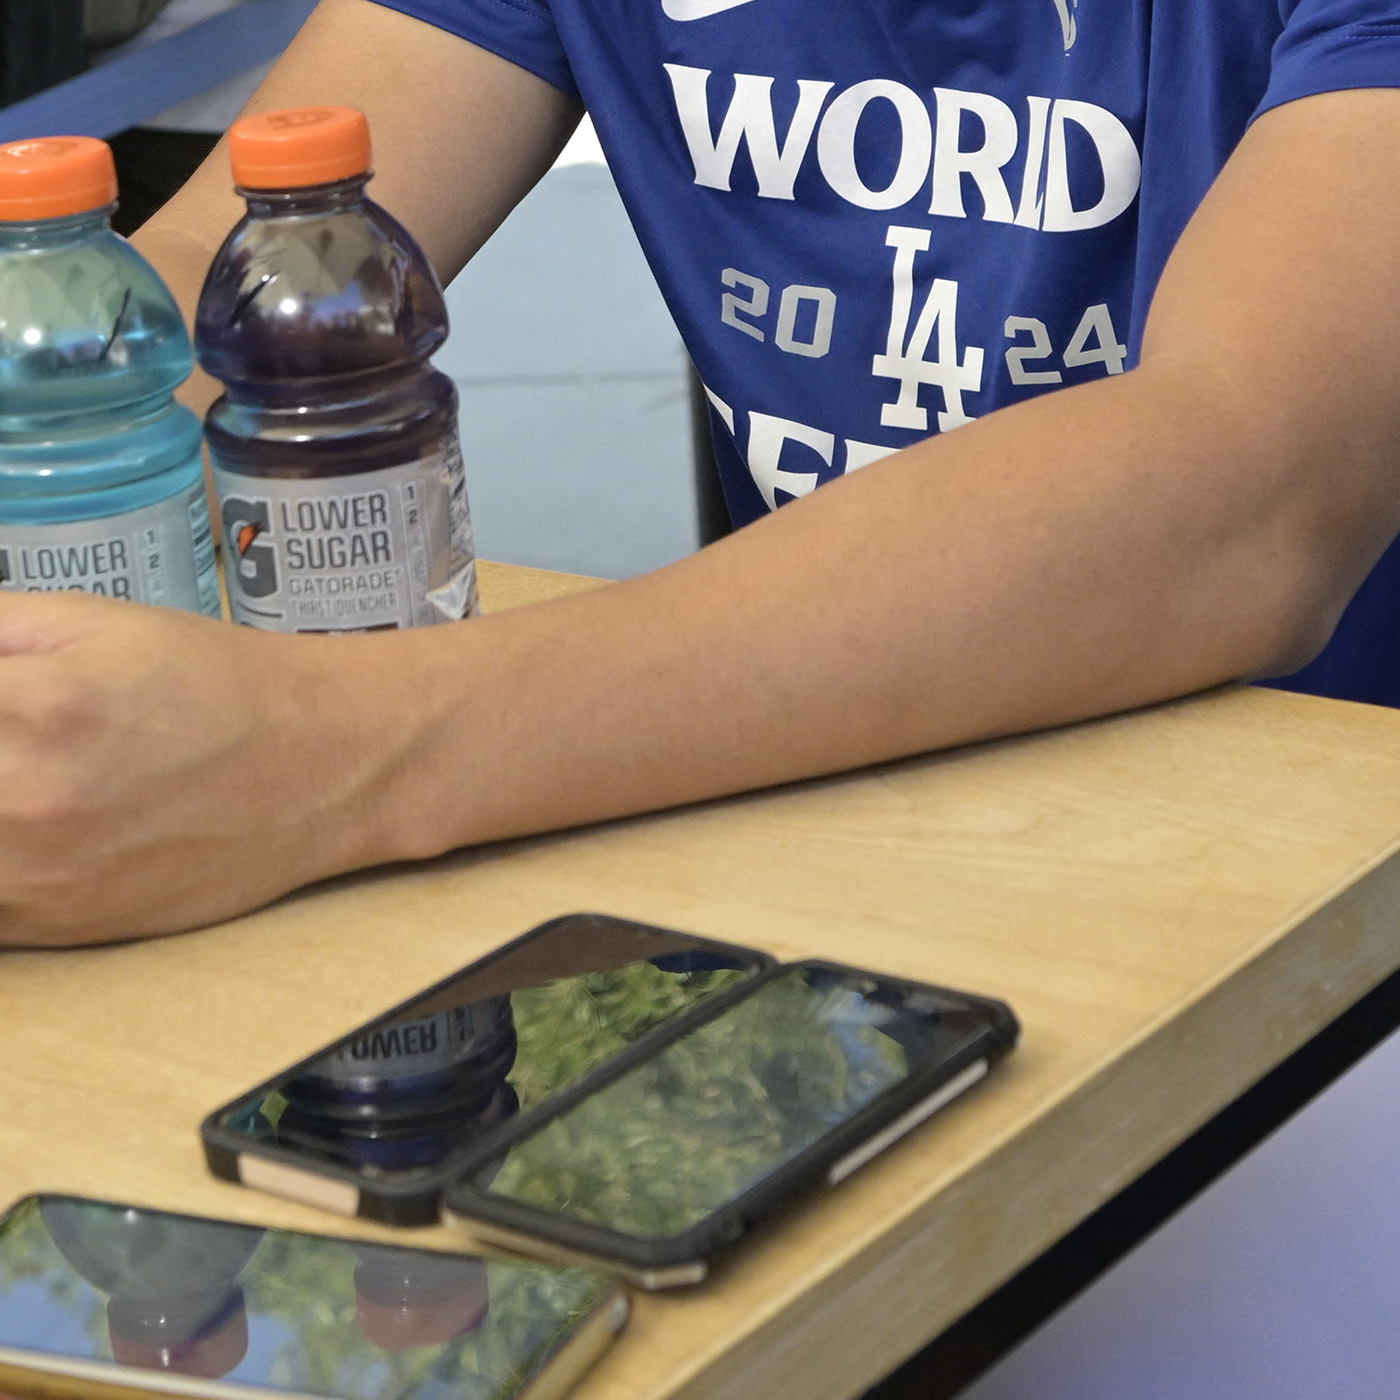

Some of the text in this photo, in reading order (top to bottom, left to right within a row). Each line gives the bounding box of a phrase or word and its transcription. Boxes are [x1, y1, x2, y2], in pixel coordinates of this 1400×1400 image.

[663, 63, 1142, 232] WORLD
[721, 225, 1127, 432] 20 LA 24
[282, 493, 387, 532] LOWER
[21, 539, 128, 580] LOWER
[287, 531, 392, 570] SUGAR
[290, 574, 394, 595] GATORADE
[297, 594, 398, 617] THIRST QUENCHER
